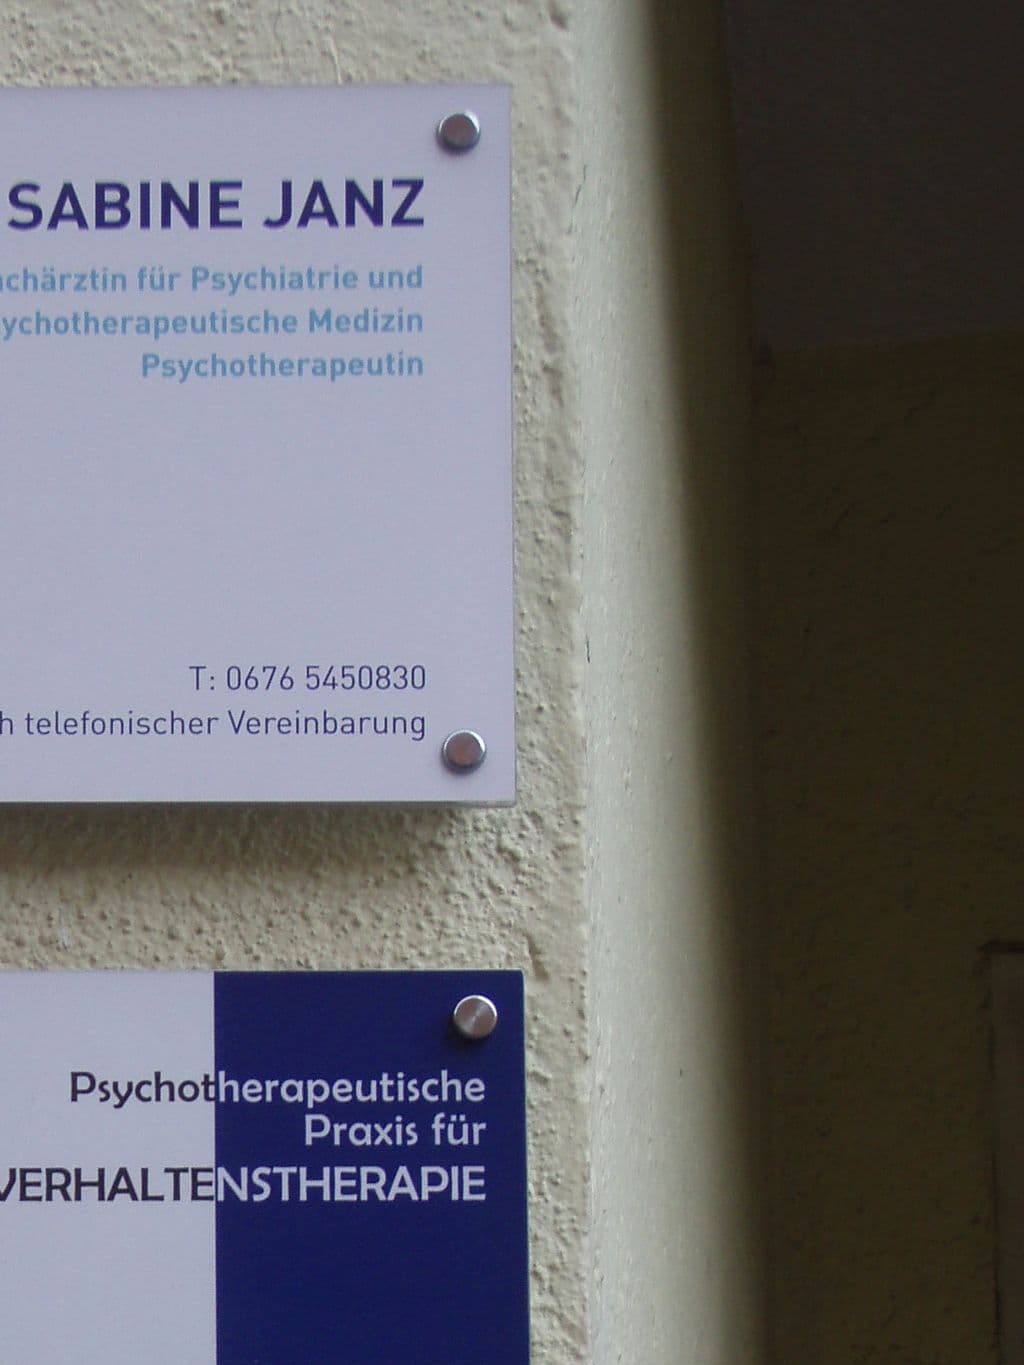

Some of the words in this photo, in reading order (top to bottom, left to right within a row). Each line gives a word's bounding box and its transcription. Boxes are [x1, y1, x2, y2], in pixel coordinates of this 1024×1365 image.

[8, 181, 242, 230] SABINE
[264, 179, 424, 228] JANZ
[138, 266, 180, 291] für
[192, 266, 358, 296] Psychiatrie
[369, 265, 422, 288] und
[309, 308, 422, 332] Medizin
[143, 352, 423, 383] Psychotherapeutin
[189, 666, 214, 690] T:
[227, 666, 294, 690] 0676
[307, 665, 425, 690] 5450830
[25, 711, 218, 735] telefonischer
[228, 710, 424, 741] Vereinbarung
[71, 1070, 485, 1108] Psychotherapeutische
[305, 1114, 417, 1145] Praxis
[432, 1113, 486, 1145] für
